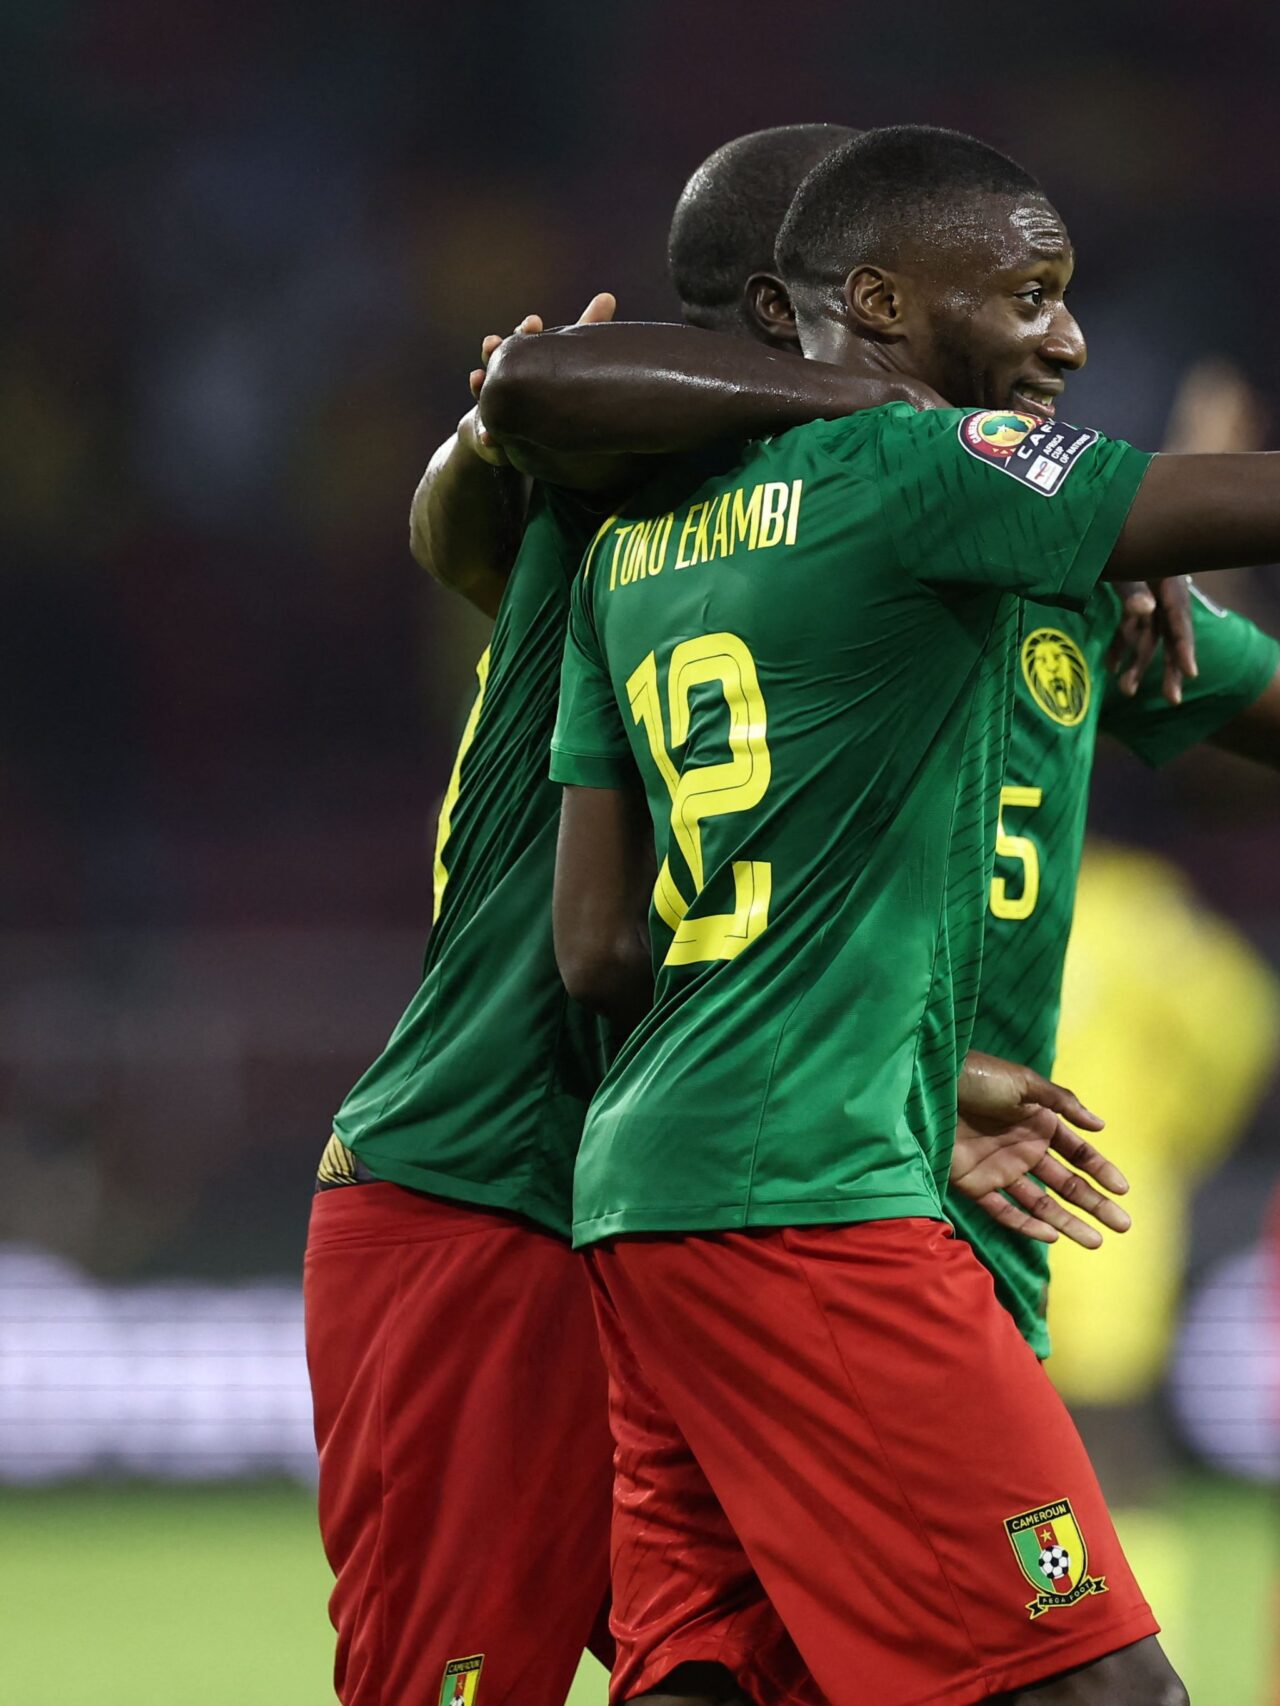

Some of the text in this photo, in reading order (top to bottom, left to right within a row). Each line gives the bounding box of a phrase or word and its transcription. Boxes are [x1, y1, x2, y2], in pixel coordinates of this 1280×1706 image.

[1043, 434, 1065, 455] AFRICA
[1051, 445, 1065, 459] CUP
[1059, 433, 1091, 464] OF NATIONS
[609, 479, 803, 591] TOKO EKAMBI
[625, 632, 772, 966] 12
[1012, 1504, 1067, 1530] CAMEROUN
